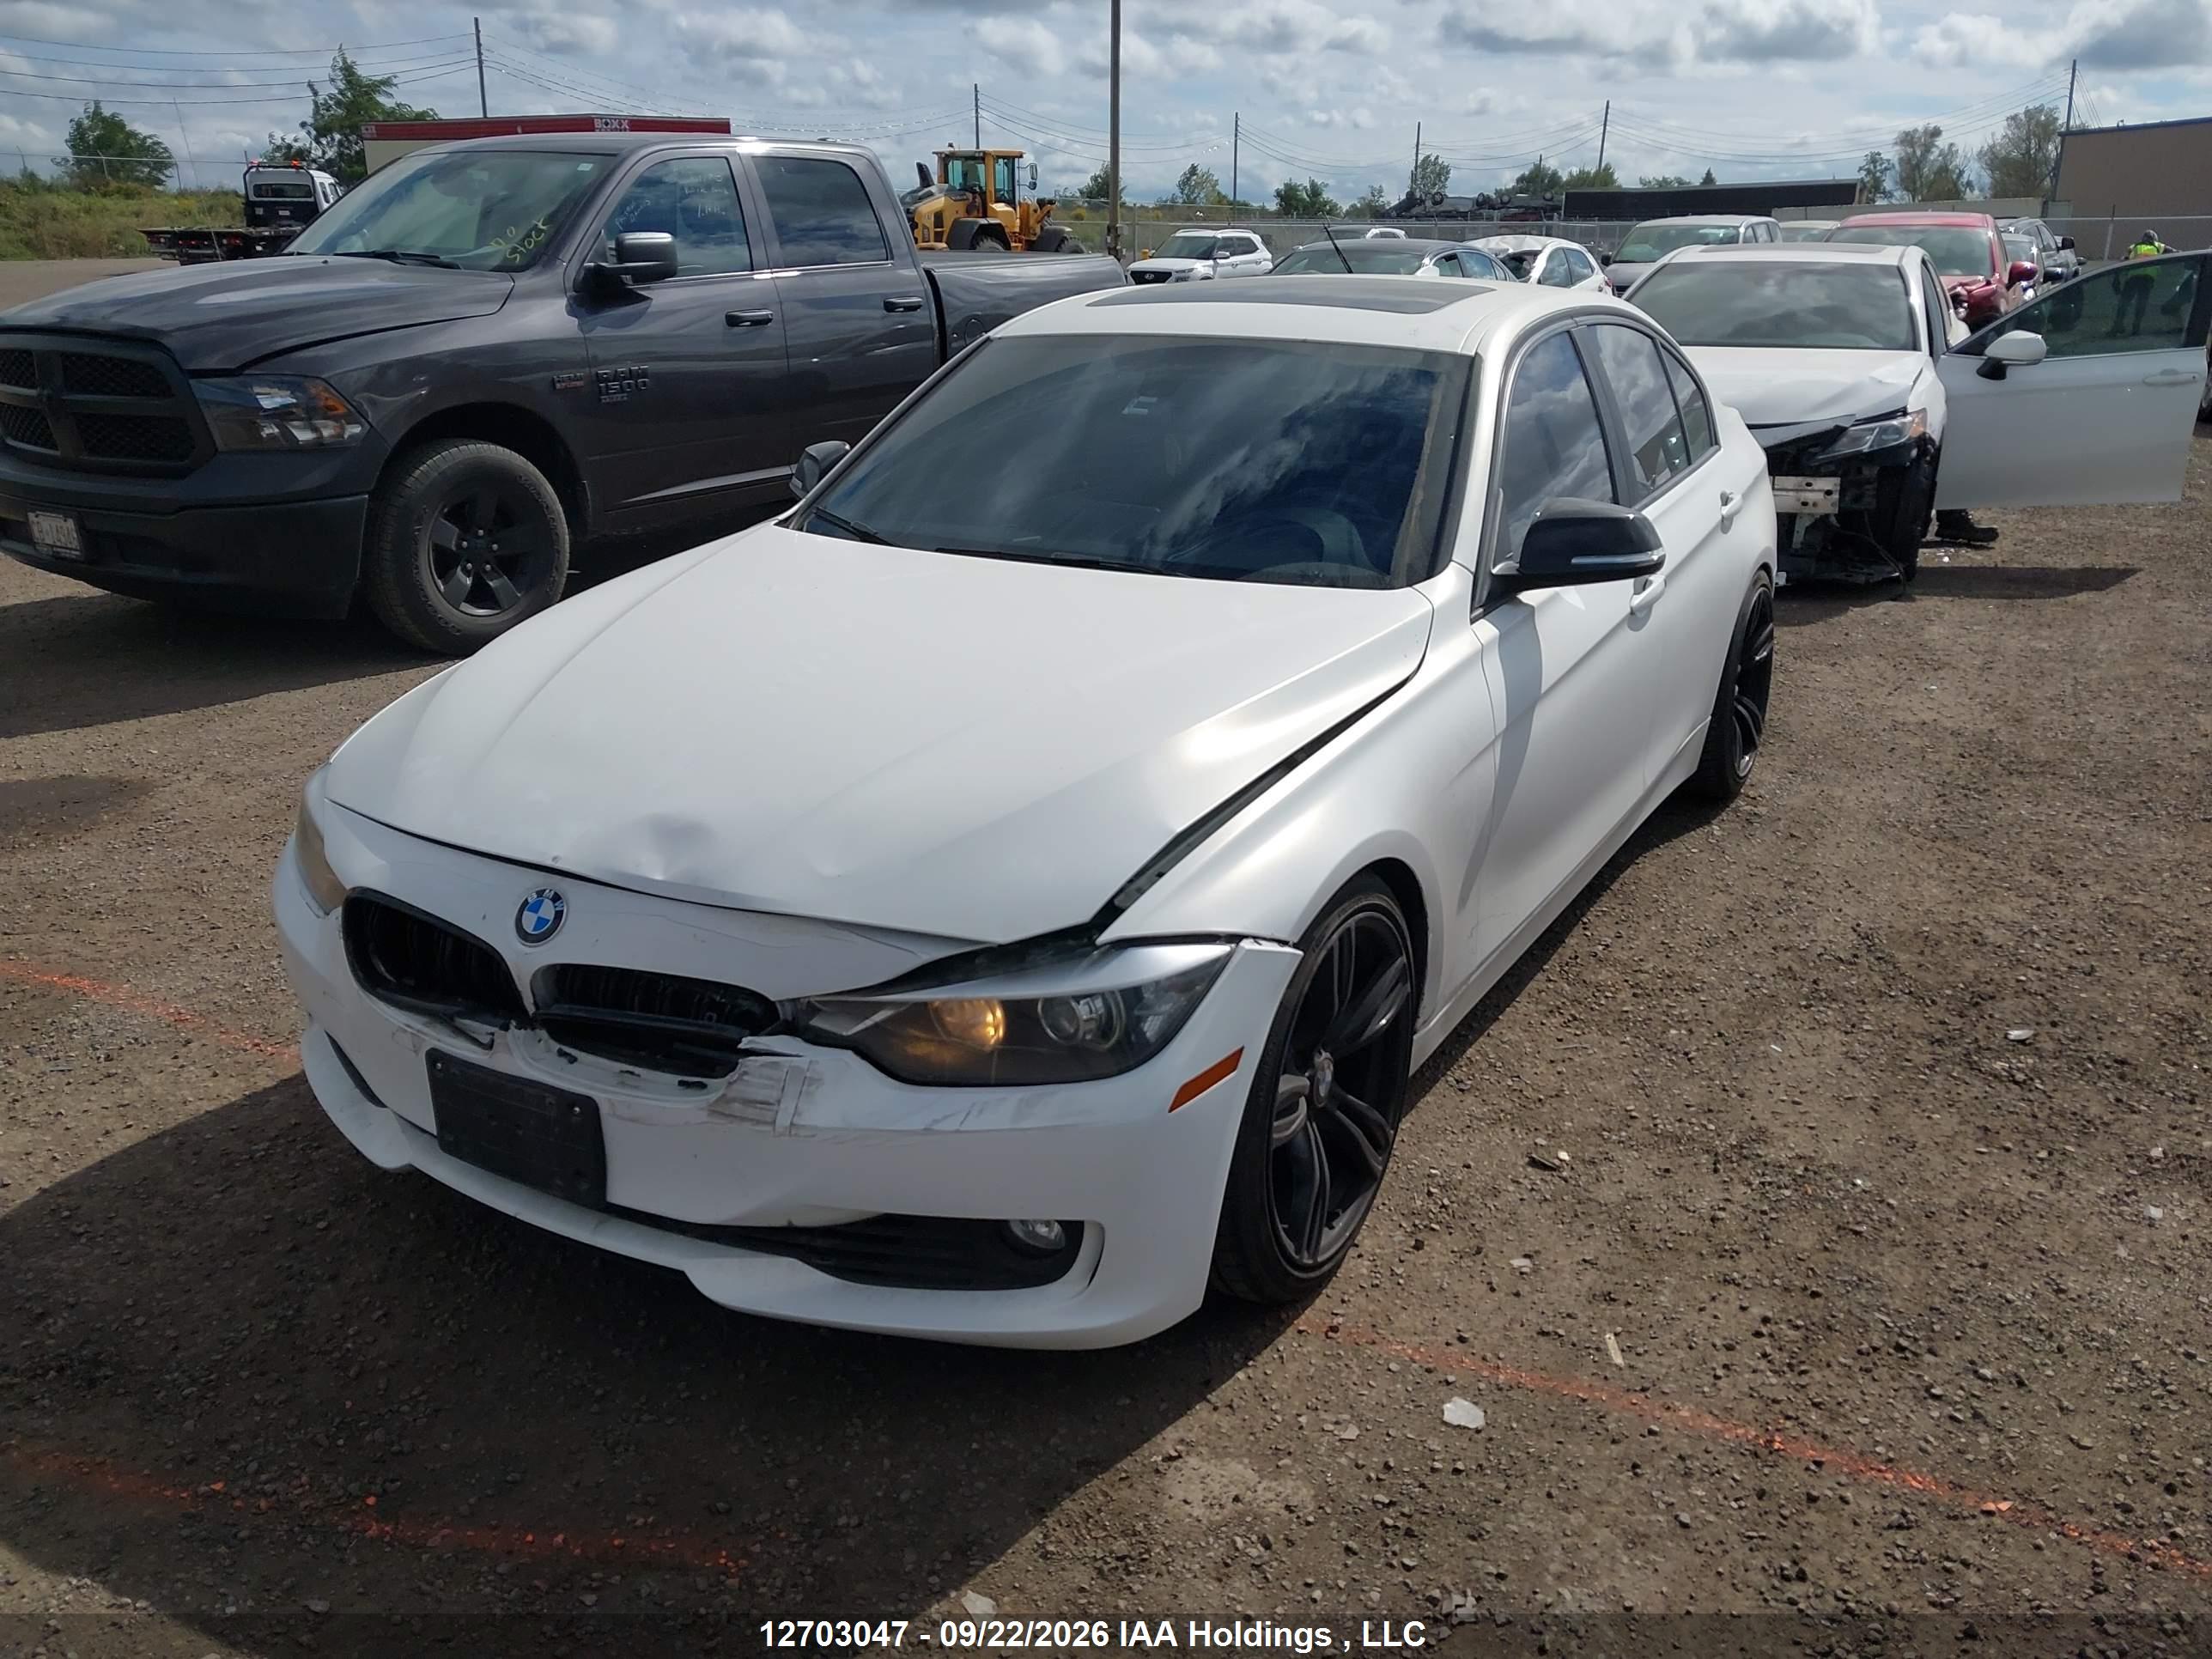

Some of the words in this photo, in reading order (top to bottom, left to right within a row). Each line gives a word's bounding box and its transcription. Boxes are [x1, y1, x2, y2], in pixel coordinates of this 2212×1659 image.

[593, 118, 629, 129] BOXX
[597, 366, 649, 380] RAM
[599, 379, 650, 393] 1500
[527, 888, 564, 911] BMW
